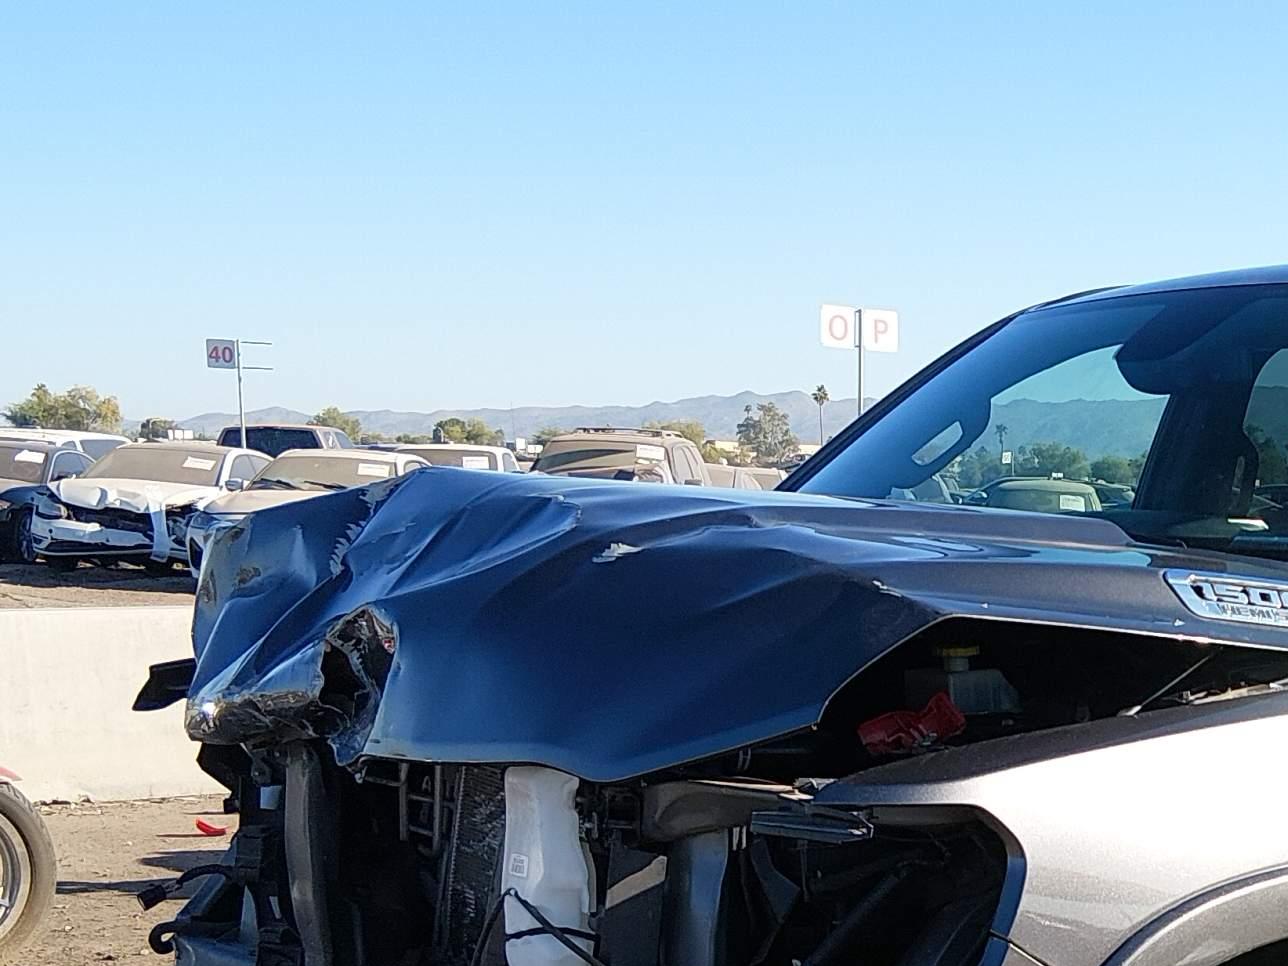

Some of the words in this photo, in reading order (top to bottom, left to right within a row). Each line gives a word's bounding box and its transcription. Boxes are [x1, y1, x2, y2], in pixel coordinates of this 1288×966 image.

[828, 314, 849, 341] O
[873, 319, 889, 344] P
[208, 346, 234, 364] 40
